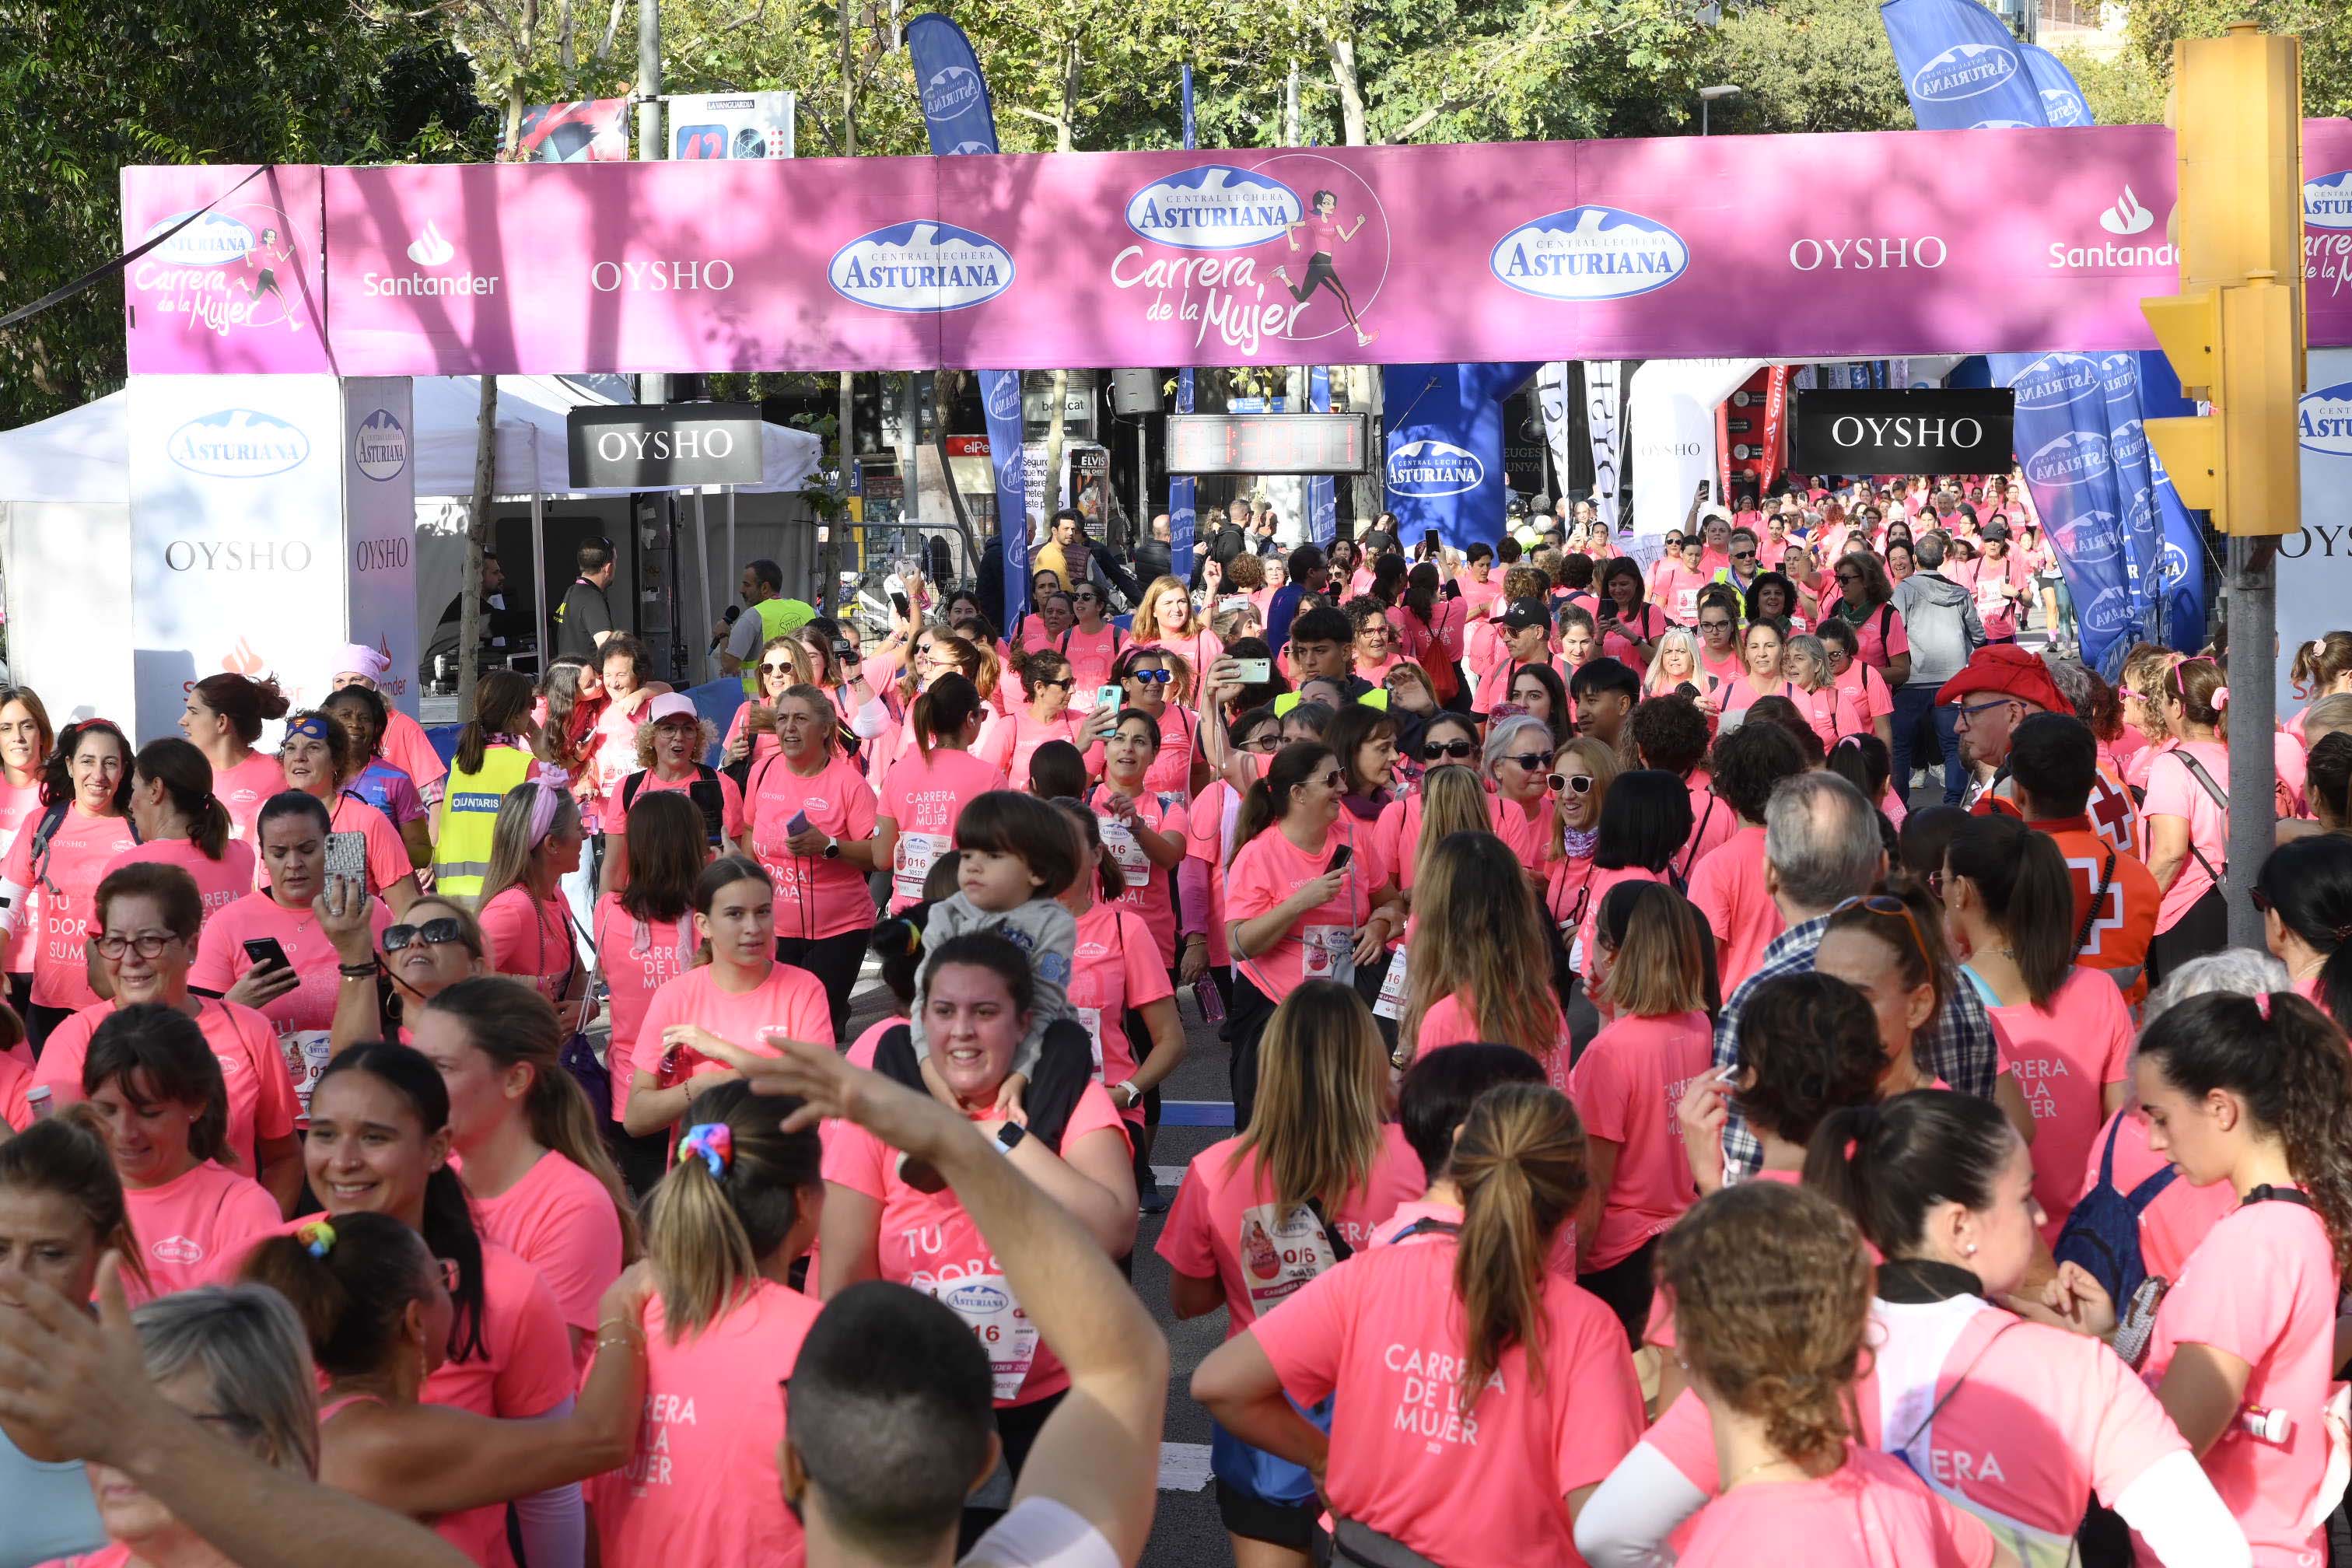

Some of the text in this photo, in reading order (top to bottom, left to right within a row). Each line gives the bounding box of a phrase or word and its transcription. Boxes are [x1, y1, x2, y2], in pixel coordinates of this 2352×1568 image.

[1167, 193, 1283, 203] CENTRAL LECHERA
[1139, 198, 1289, 229] ASTURIANA
[871, 250, 995, 261] CENTRAL LECHERA
[1536, 237, 1668, 249] CENTRAL LECHERA
[1789, 236, 1947, 271] OYSHO
[843, 255, 1000, 289] ASTURIANA
[1111, 245, 1258, 289] Carrera
[1506, 242, 1674, 277] ASTURIANA
[135, 261, 226, 291] Carrera
[363, 271, 499, 296] Santander
[591, 259, 734, 292] OYSHO
[158, 289, 261, 336] de la Mujer
[1146, 283, 1311, 356] de la Mujer
[598, 428, 733, 462] OYSHO
[1832, 416, 1983, 449] OYSHO
[180, 435, 299, 461] ASTURIANA
[359, 439, 404, 464] ASTURIANA
[1082, 456, 1105, 466] ELVIS
[1389, 463, 1477, 485] ASTURIANA
[165, 541, 312, 572] OYSHO
[357, 537, 408, 572] OYSHO
[906, 790, 956, 804] CARRERA
[918, 803, 947, 814] DE LA
[916, 814, 947, 826] MUJER
[54, 839, 86, 848] OYSHO
[908, 857, 926, 868] 016
[47, 894, 70, 911] TU
[644, 961, 667, 975] DE
[2022, 1080, 2050, 1098] LA
[902, 1223, 943, 1258] TU
[952, 1294, 1003, 1307] ASTURIANA
[1403, 1376, 1438, 1409] DE
[1394, 1405, 1479, 1447] MUJER
